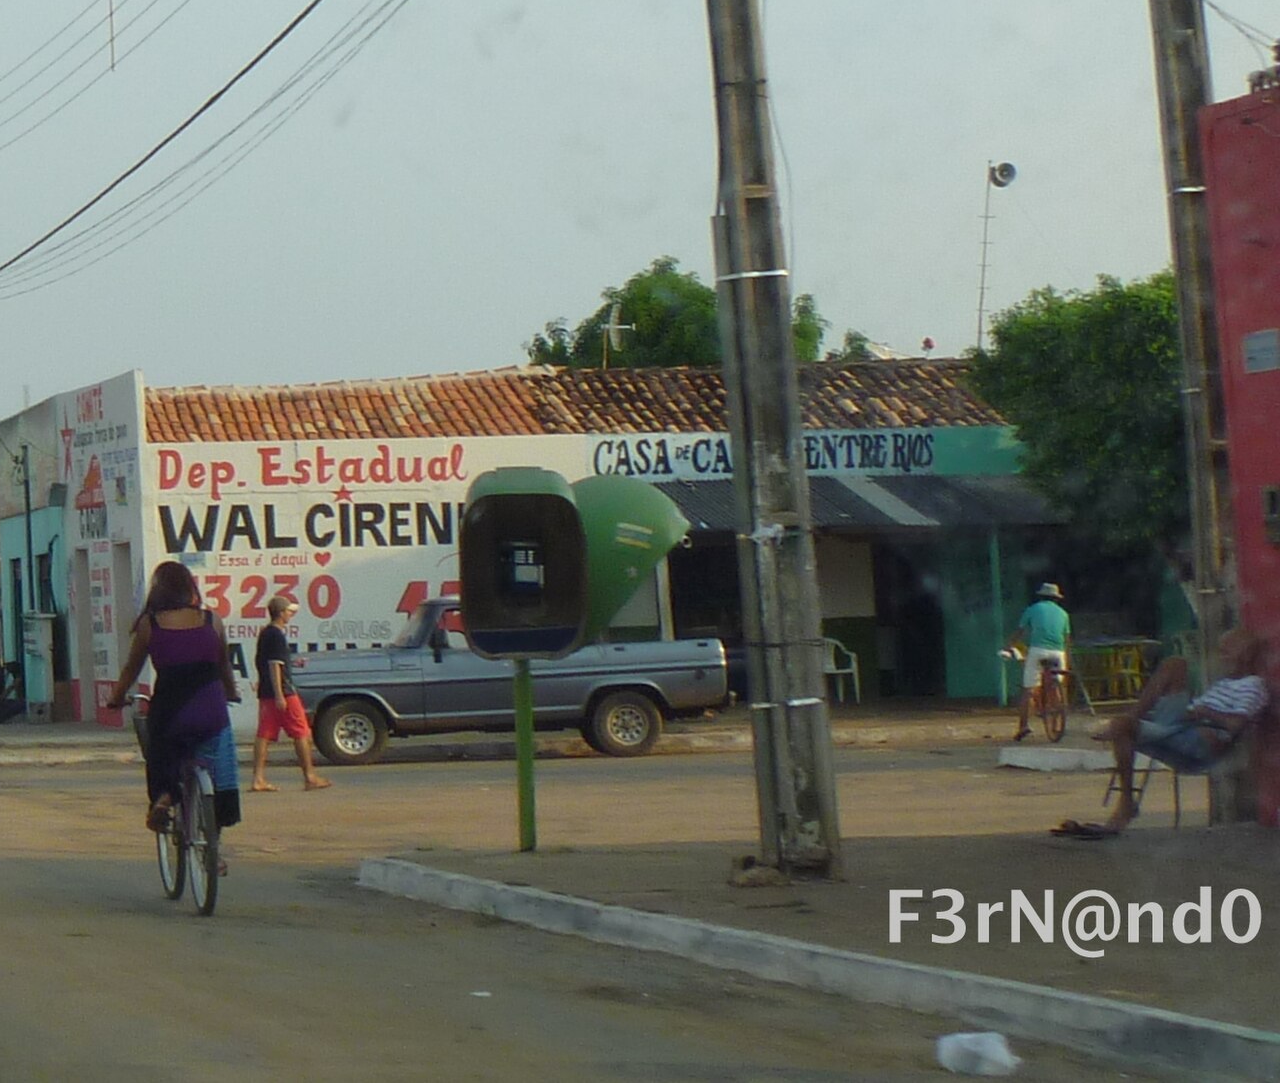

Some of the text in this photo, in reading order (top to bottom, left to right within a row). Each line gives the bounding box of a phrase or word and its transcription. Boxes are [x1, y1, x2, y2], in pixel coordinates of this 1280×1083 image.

[594, 439, 673, 475] CASA
[675, 445, 690, 460] DE
[892, 433, 934, 472] RIOS
[158, 444, 467, 500] Dep. Estadual
[218, 552, 309, 568] Essa é daqui
[317, 620, 391, 639] CARLOS
